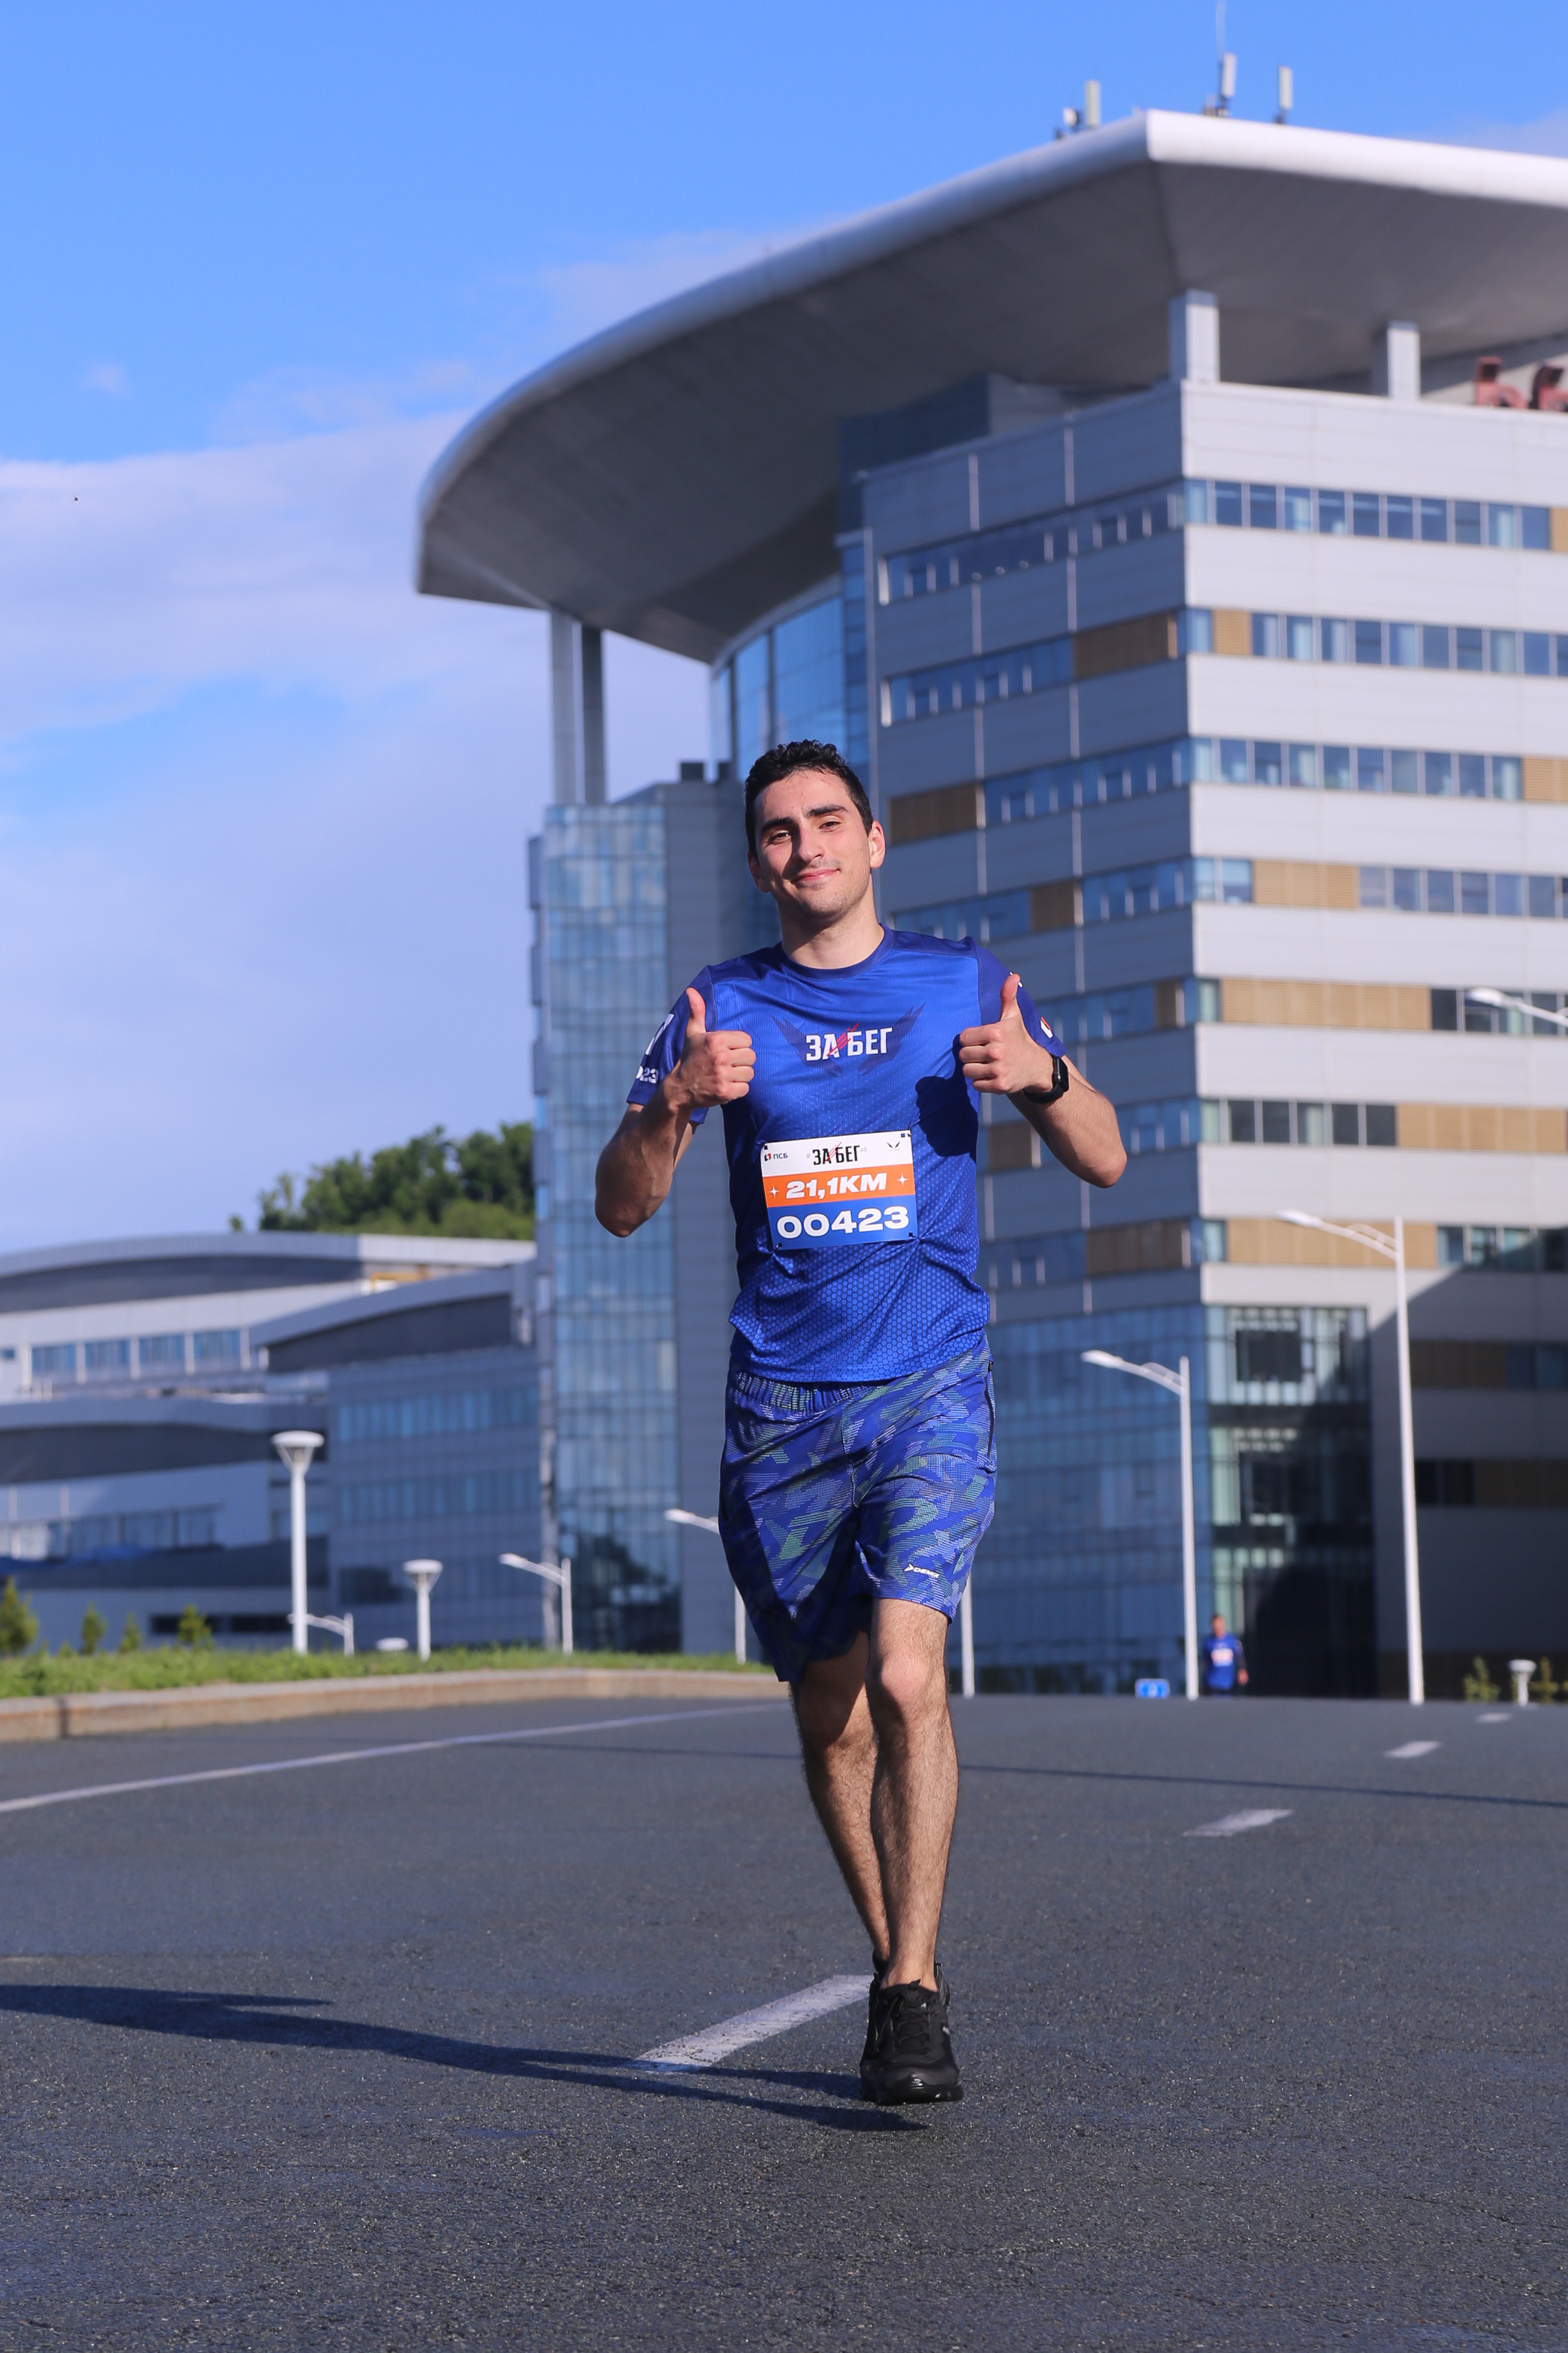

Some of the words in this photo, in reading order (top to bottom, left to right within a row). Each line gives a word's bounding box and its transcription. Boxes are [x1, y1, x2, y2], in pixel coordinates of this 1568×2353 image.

[786, 1172, 887, 1199] 21,1КМ
[776, 1205, 910, 1240] 00423
[913, 1567, 941, 1578] DEMIX
